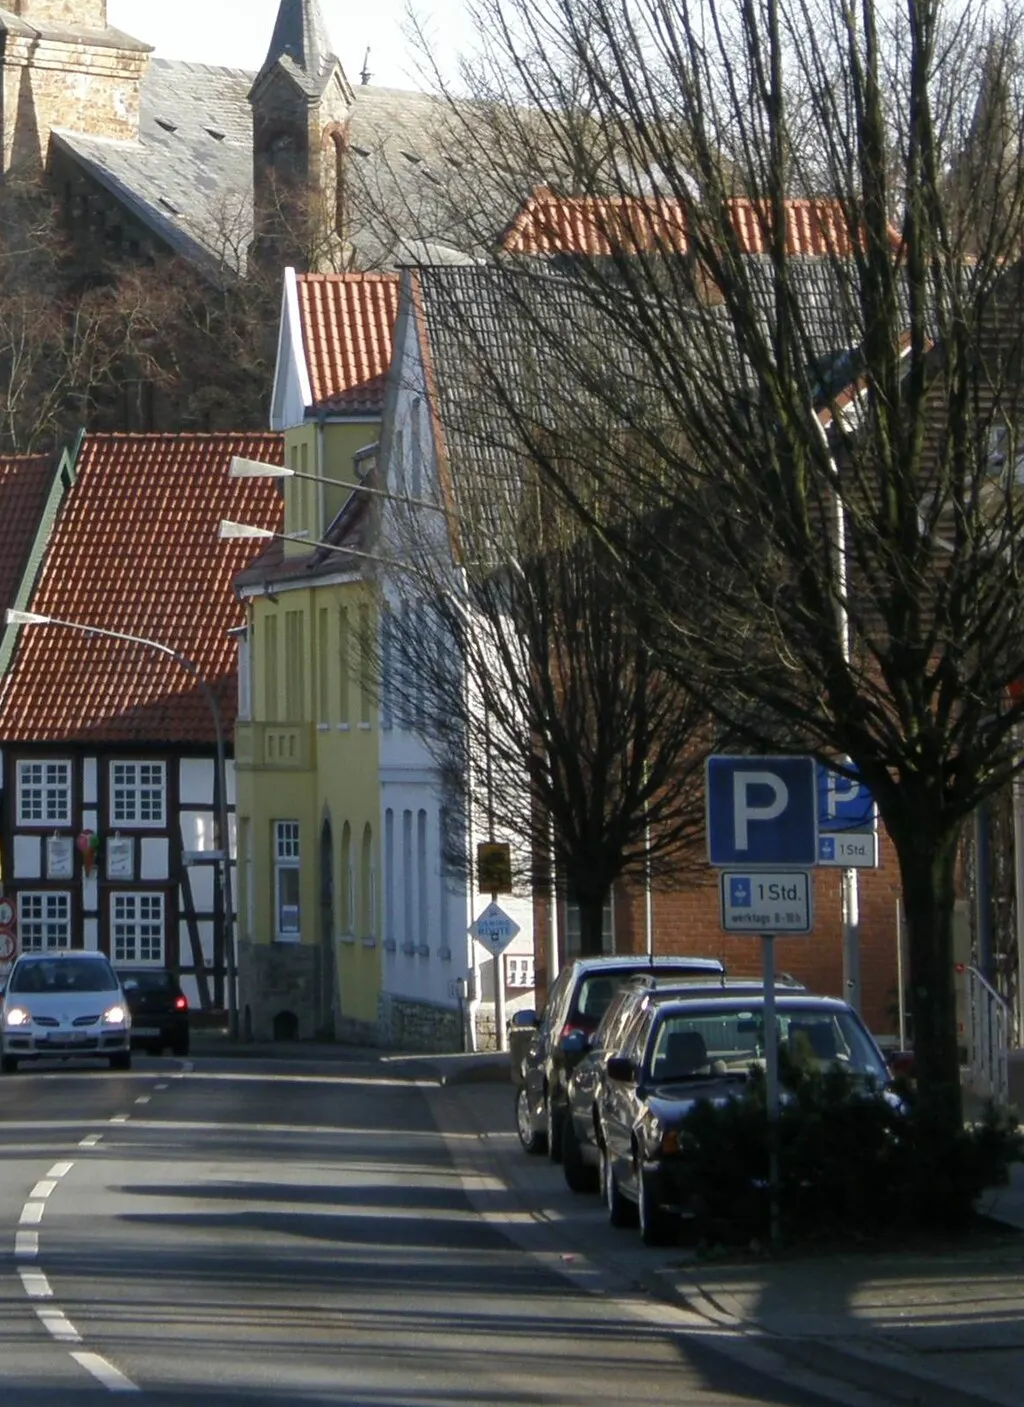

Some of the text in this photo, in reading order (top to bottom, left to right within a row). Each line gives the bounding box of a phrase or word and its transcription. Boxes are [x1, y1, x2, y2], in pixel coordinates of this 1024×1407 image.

[733, 771, 789, 850] P
[827, 770, 860, 819] P
[840, 844, 868, 856] 1 Std.
[758, 883, 802, 901] 1 Std.
